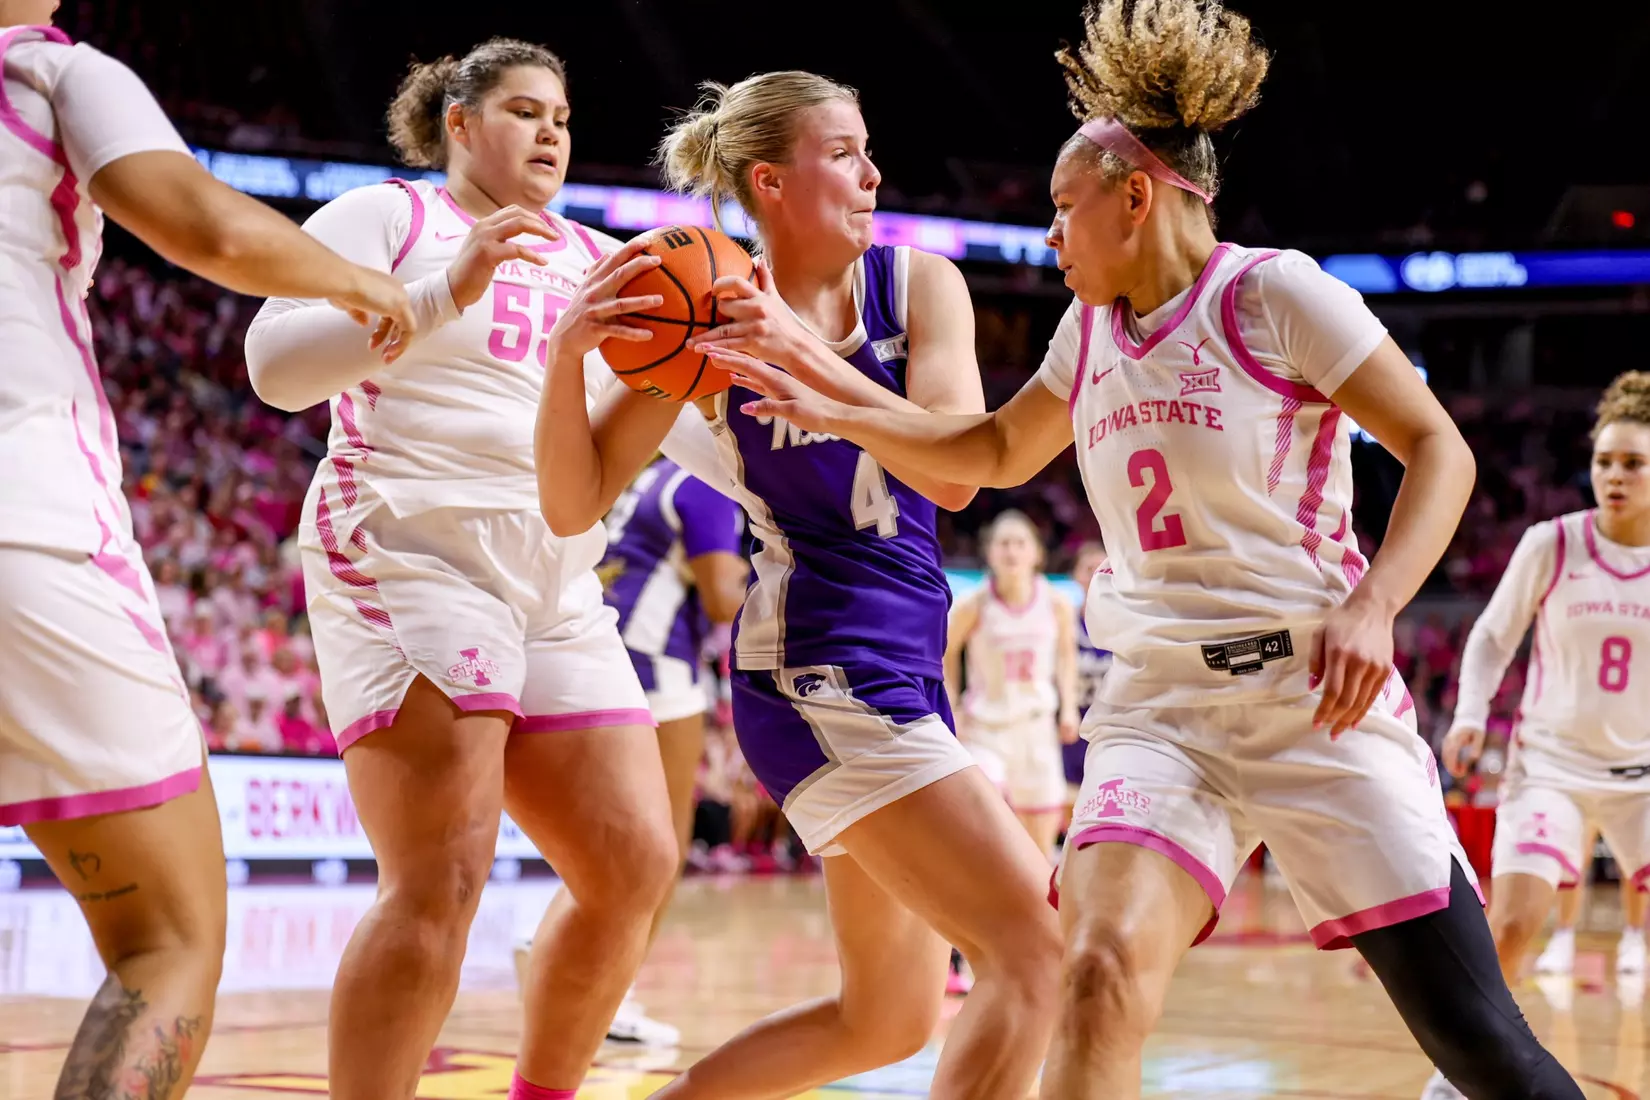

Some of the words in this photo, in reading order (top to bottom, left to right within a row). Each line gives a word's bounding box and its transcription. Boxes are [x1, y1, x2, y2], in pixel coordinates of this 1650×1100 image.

[1181, 370, 1220, 395] XII
[1088, 401, 1137, 450] IOWA
[1137, 399, 1224, 431] STATE
[850, 450, 900, 540] 4
[1127, 448, 1187, 552] 2
[1618, 602, 1650, 621] STA
[1264, 640, 1280, 653] 42
[1598, 636, 1631, 694] 8
[448, 659, 502, 683] STATE
